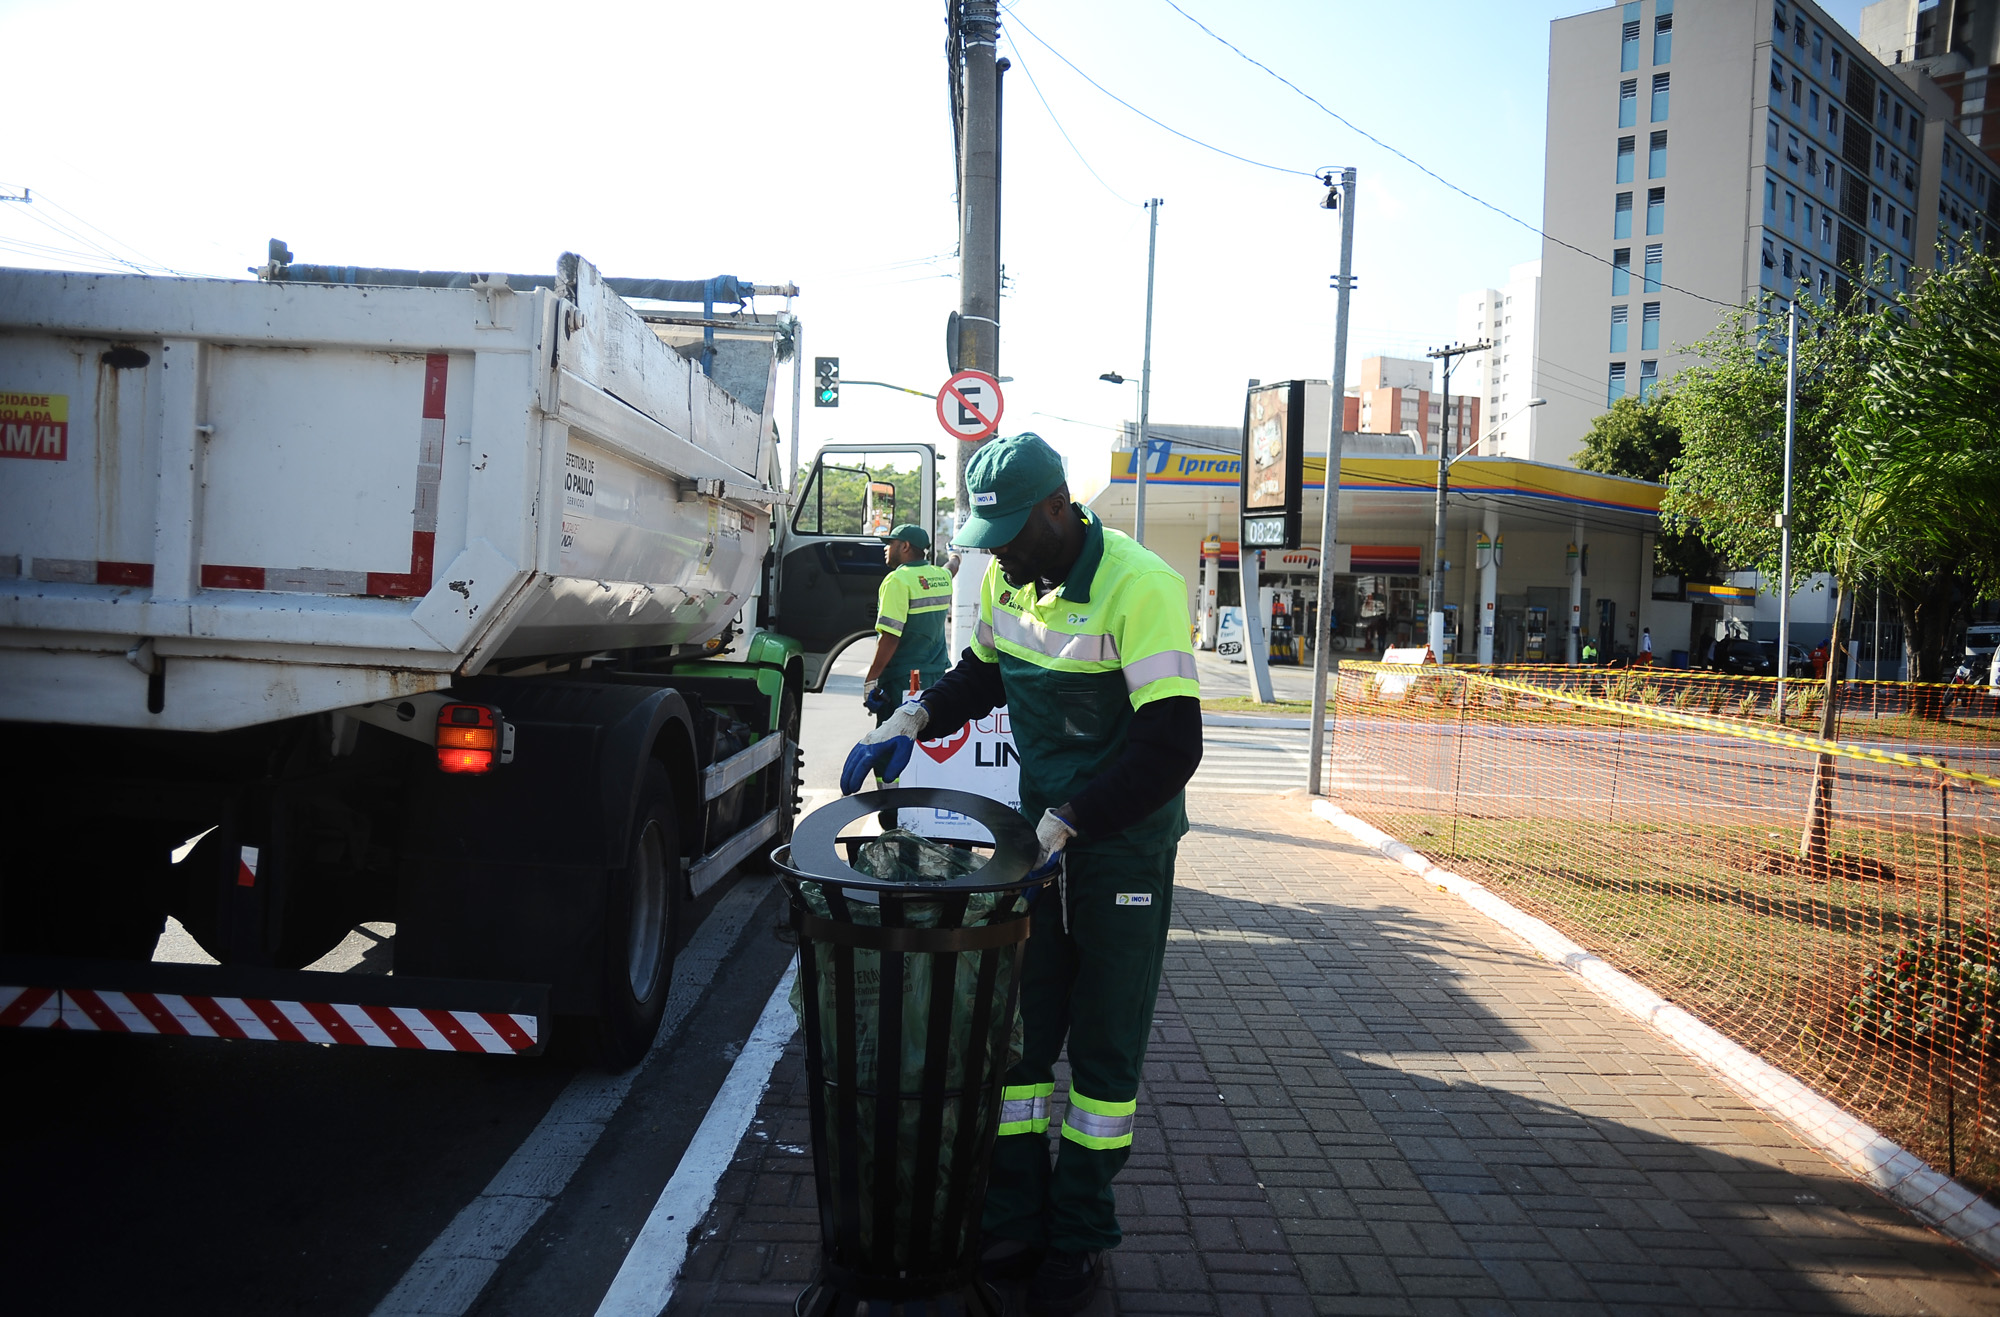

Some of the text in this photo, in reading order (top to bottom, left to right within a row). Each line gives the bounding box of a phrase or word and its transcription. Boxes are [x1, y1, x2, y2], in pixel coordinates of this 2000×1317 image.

[958, 387, 981, 425] E
[1178, 456, 1242, 476] Ipiran
[573, 474, 594, 497] PAULO
[1250, 521, 1282, 543] 08:22
[1283, 555, 1321, 569] amp
[975, 713, 1013, 734] CID
[975, 742, 1021, 767] LIN
